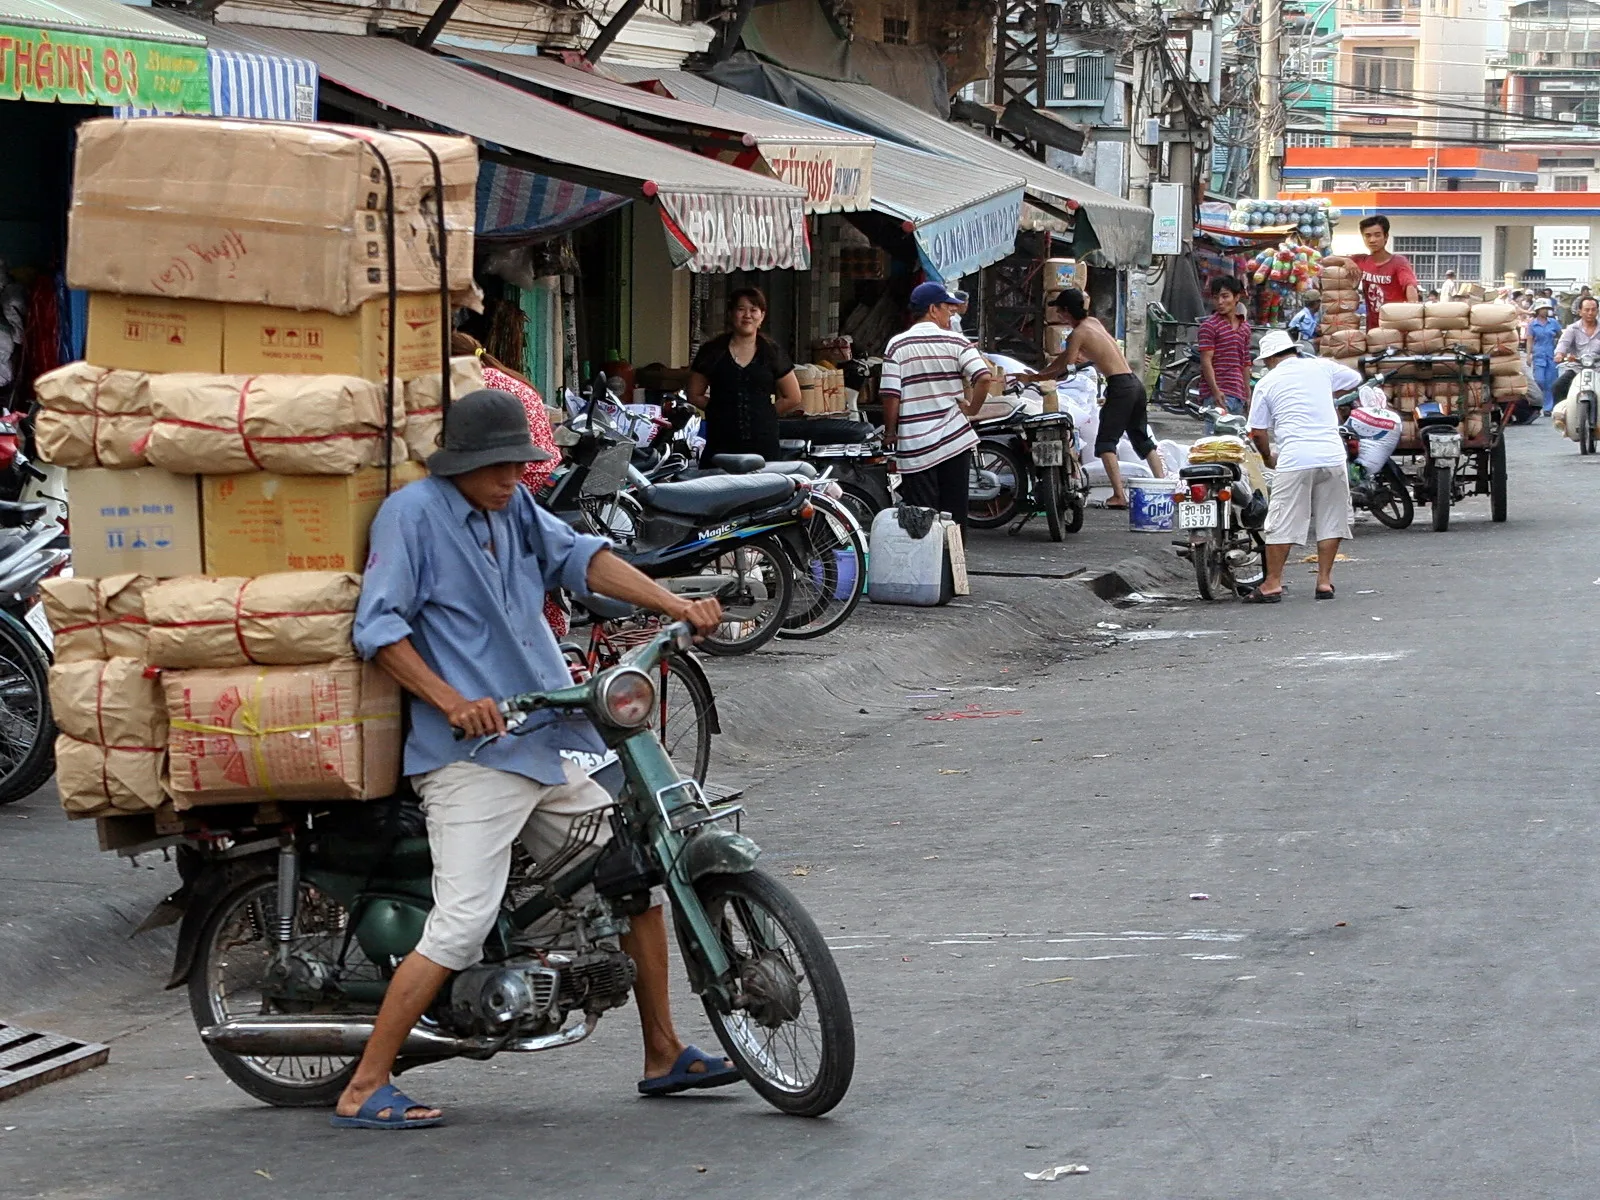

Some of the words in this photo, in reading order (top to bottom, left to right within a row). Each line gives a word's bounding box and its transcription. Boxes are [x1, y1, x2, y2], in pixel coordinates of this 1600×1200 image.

[0, 32, 95, 97] THÀNH
[103, 48, 138, 96] 83
[690, 210, 731, 256] HOA
[1147, 500, 1174, 518] OMO
[697, 524, 731, 541] Magic
